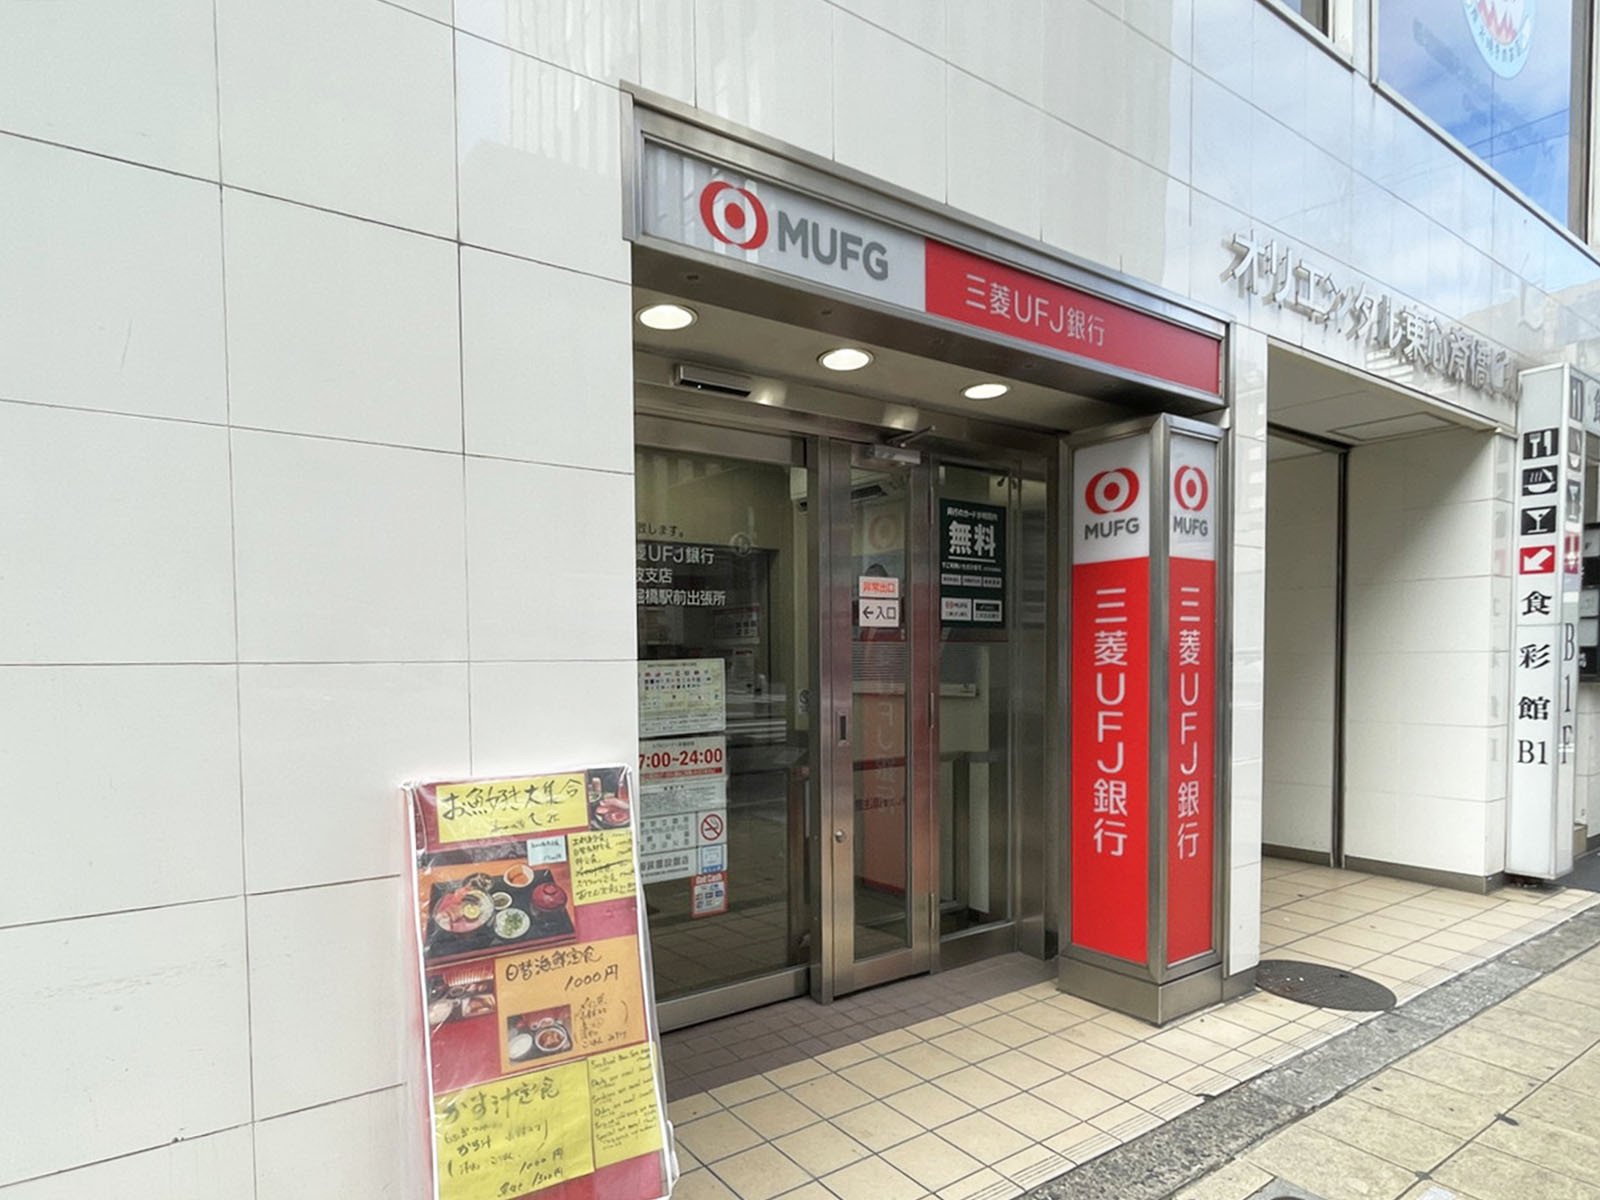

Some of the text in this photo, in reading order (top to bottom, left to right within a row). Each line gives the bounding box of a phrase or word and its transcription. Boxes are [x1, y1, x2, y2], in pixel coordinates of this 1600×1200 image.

[777, 209, 889, 281] MUFG
[965, 272, 1106, 348] 三菱UFJ銀行
[949, 520, 996, 557] 無料
[1084, 516, 1140, 541] MUFG
[1173, 515, 1208, 538] MUFG
[875, 606, 897, 620] 入口
[1516, 590, 1553, 765] 食彩館 B1
[1093, 587, 1129, 857] 三菱UFJ銀行
[1177, 586, 1202, 860] 三菱UFJ銀行
[563, 963, 619, 991] 1000円
